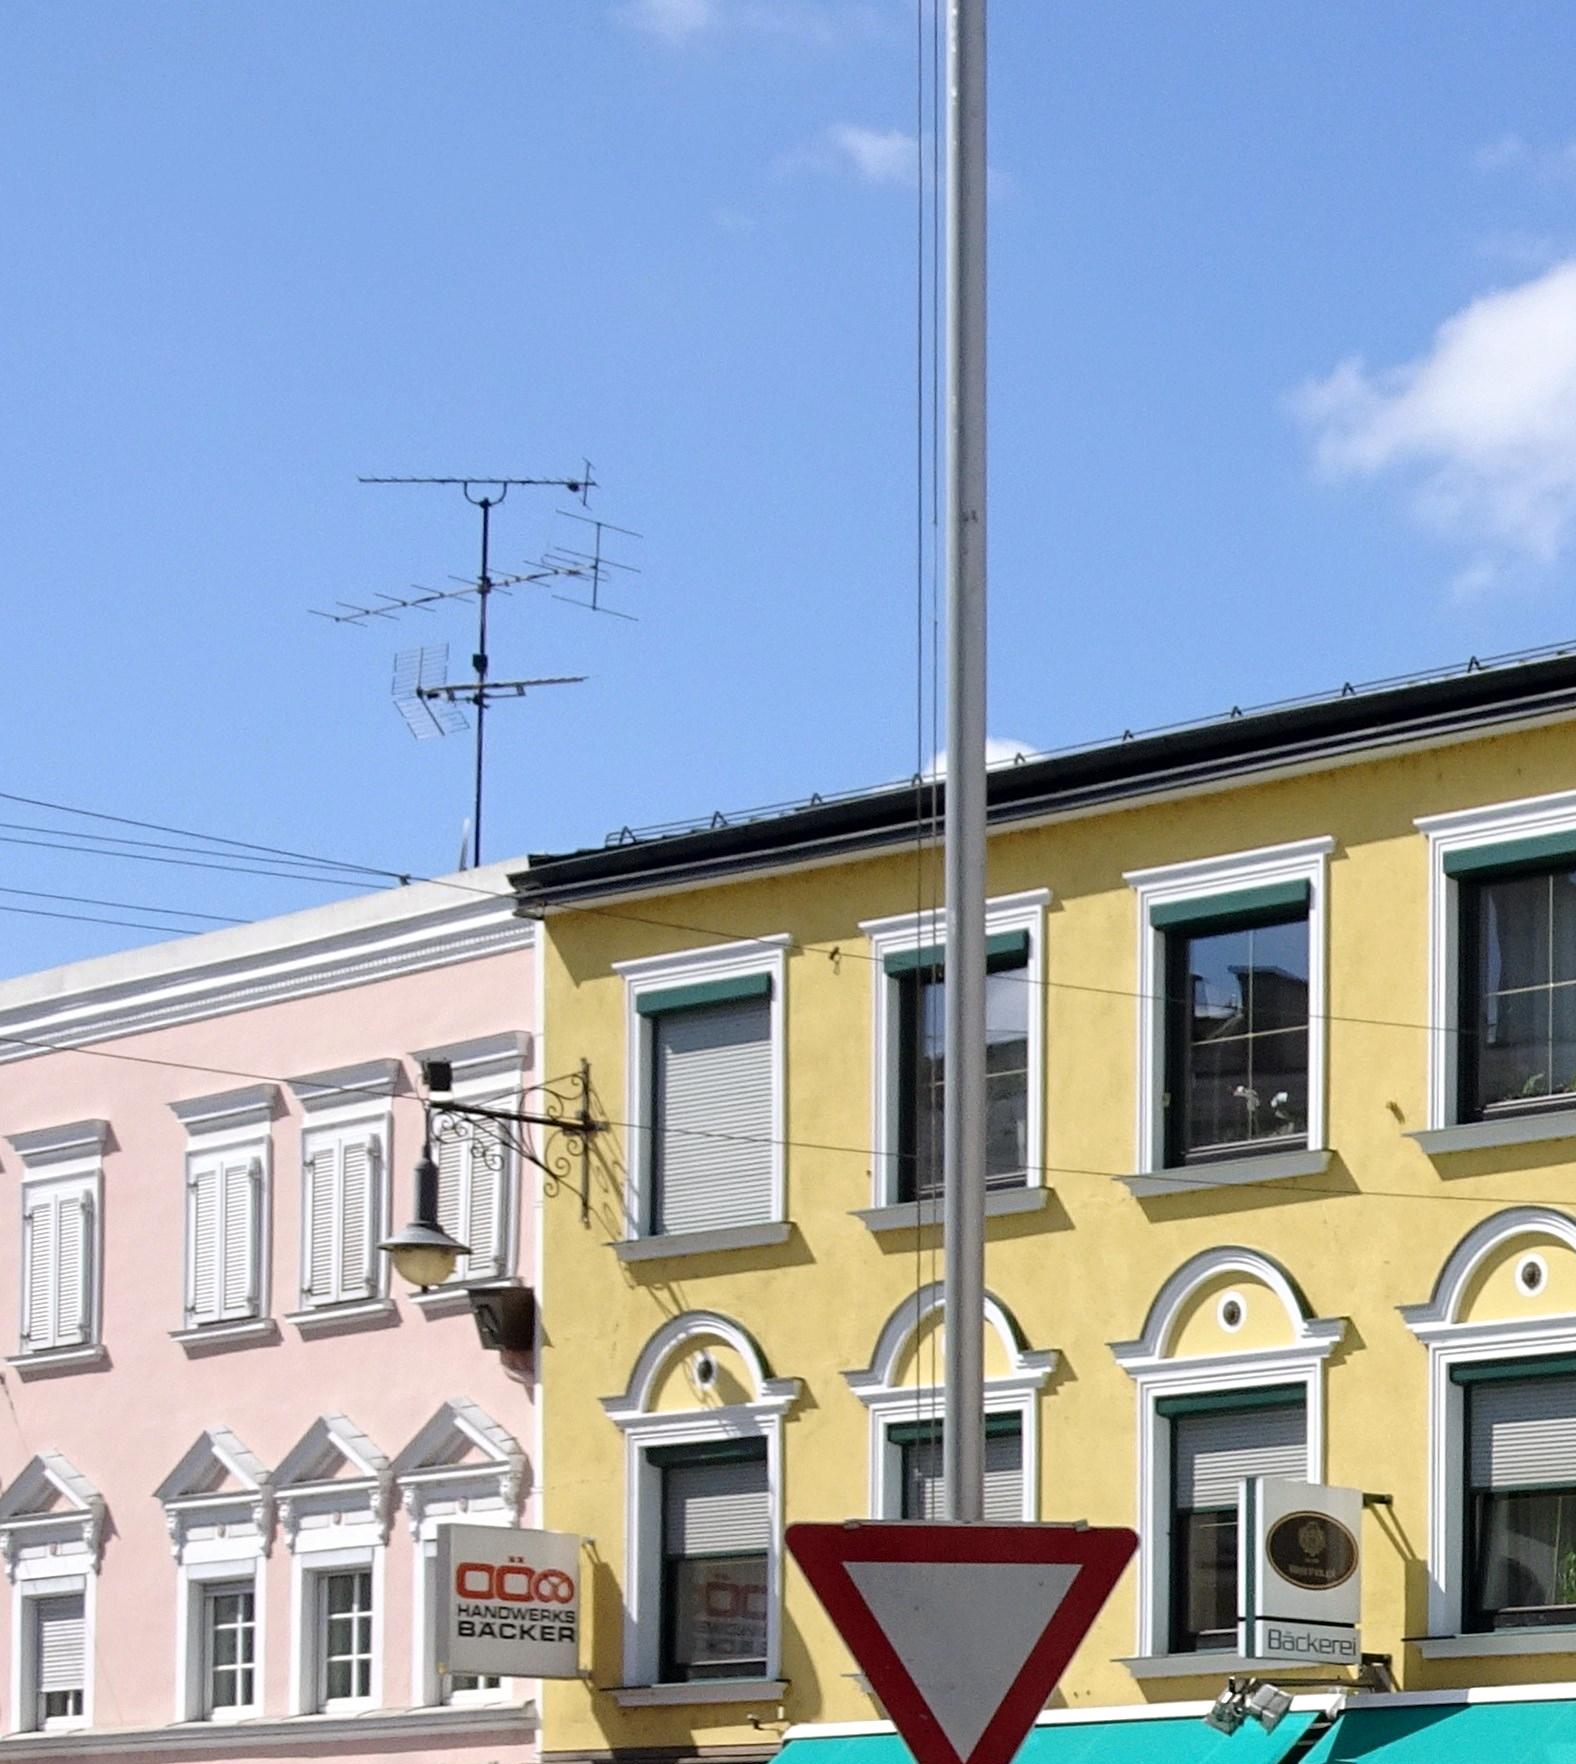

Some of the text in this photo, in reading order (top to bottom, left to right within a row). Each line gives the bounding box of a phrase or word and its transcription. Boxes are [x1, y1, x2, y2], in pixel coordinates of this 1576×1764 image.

[457, 1603, 576, 1624] HANDWERKS
[458, 1619, 576, 1645] BÄCKER
[1268, 1628, 1358, 1657] Bäckerei
